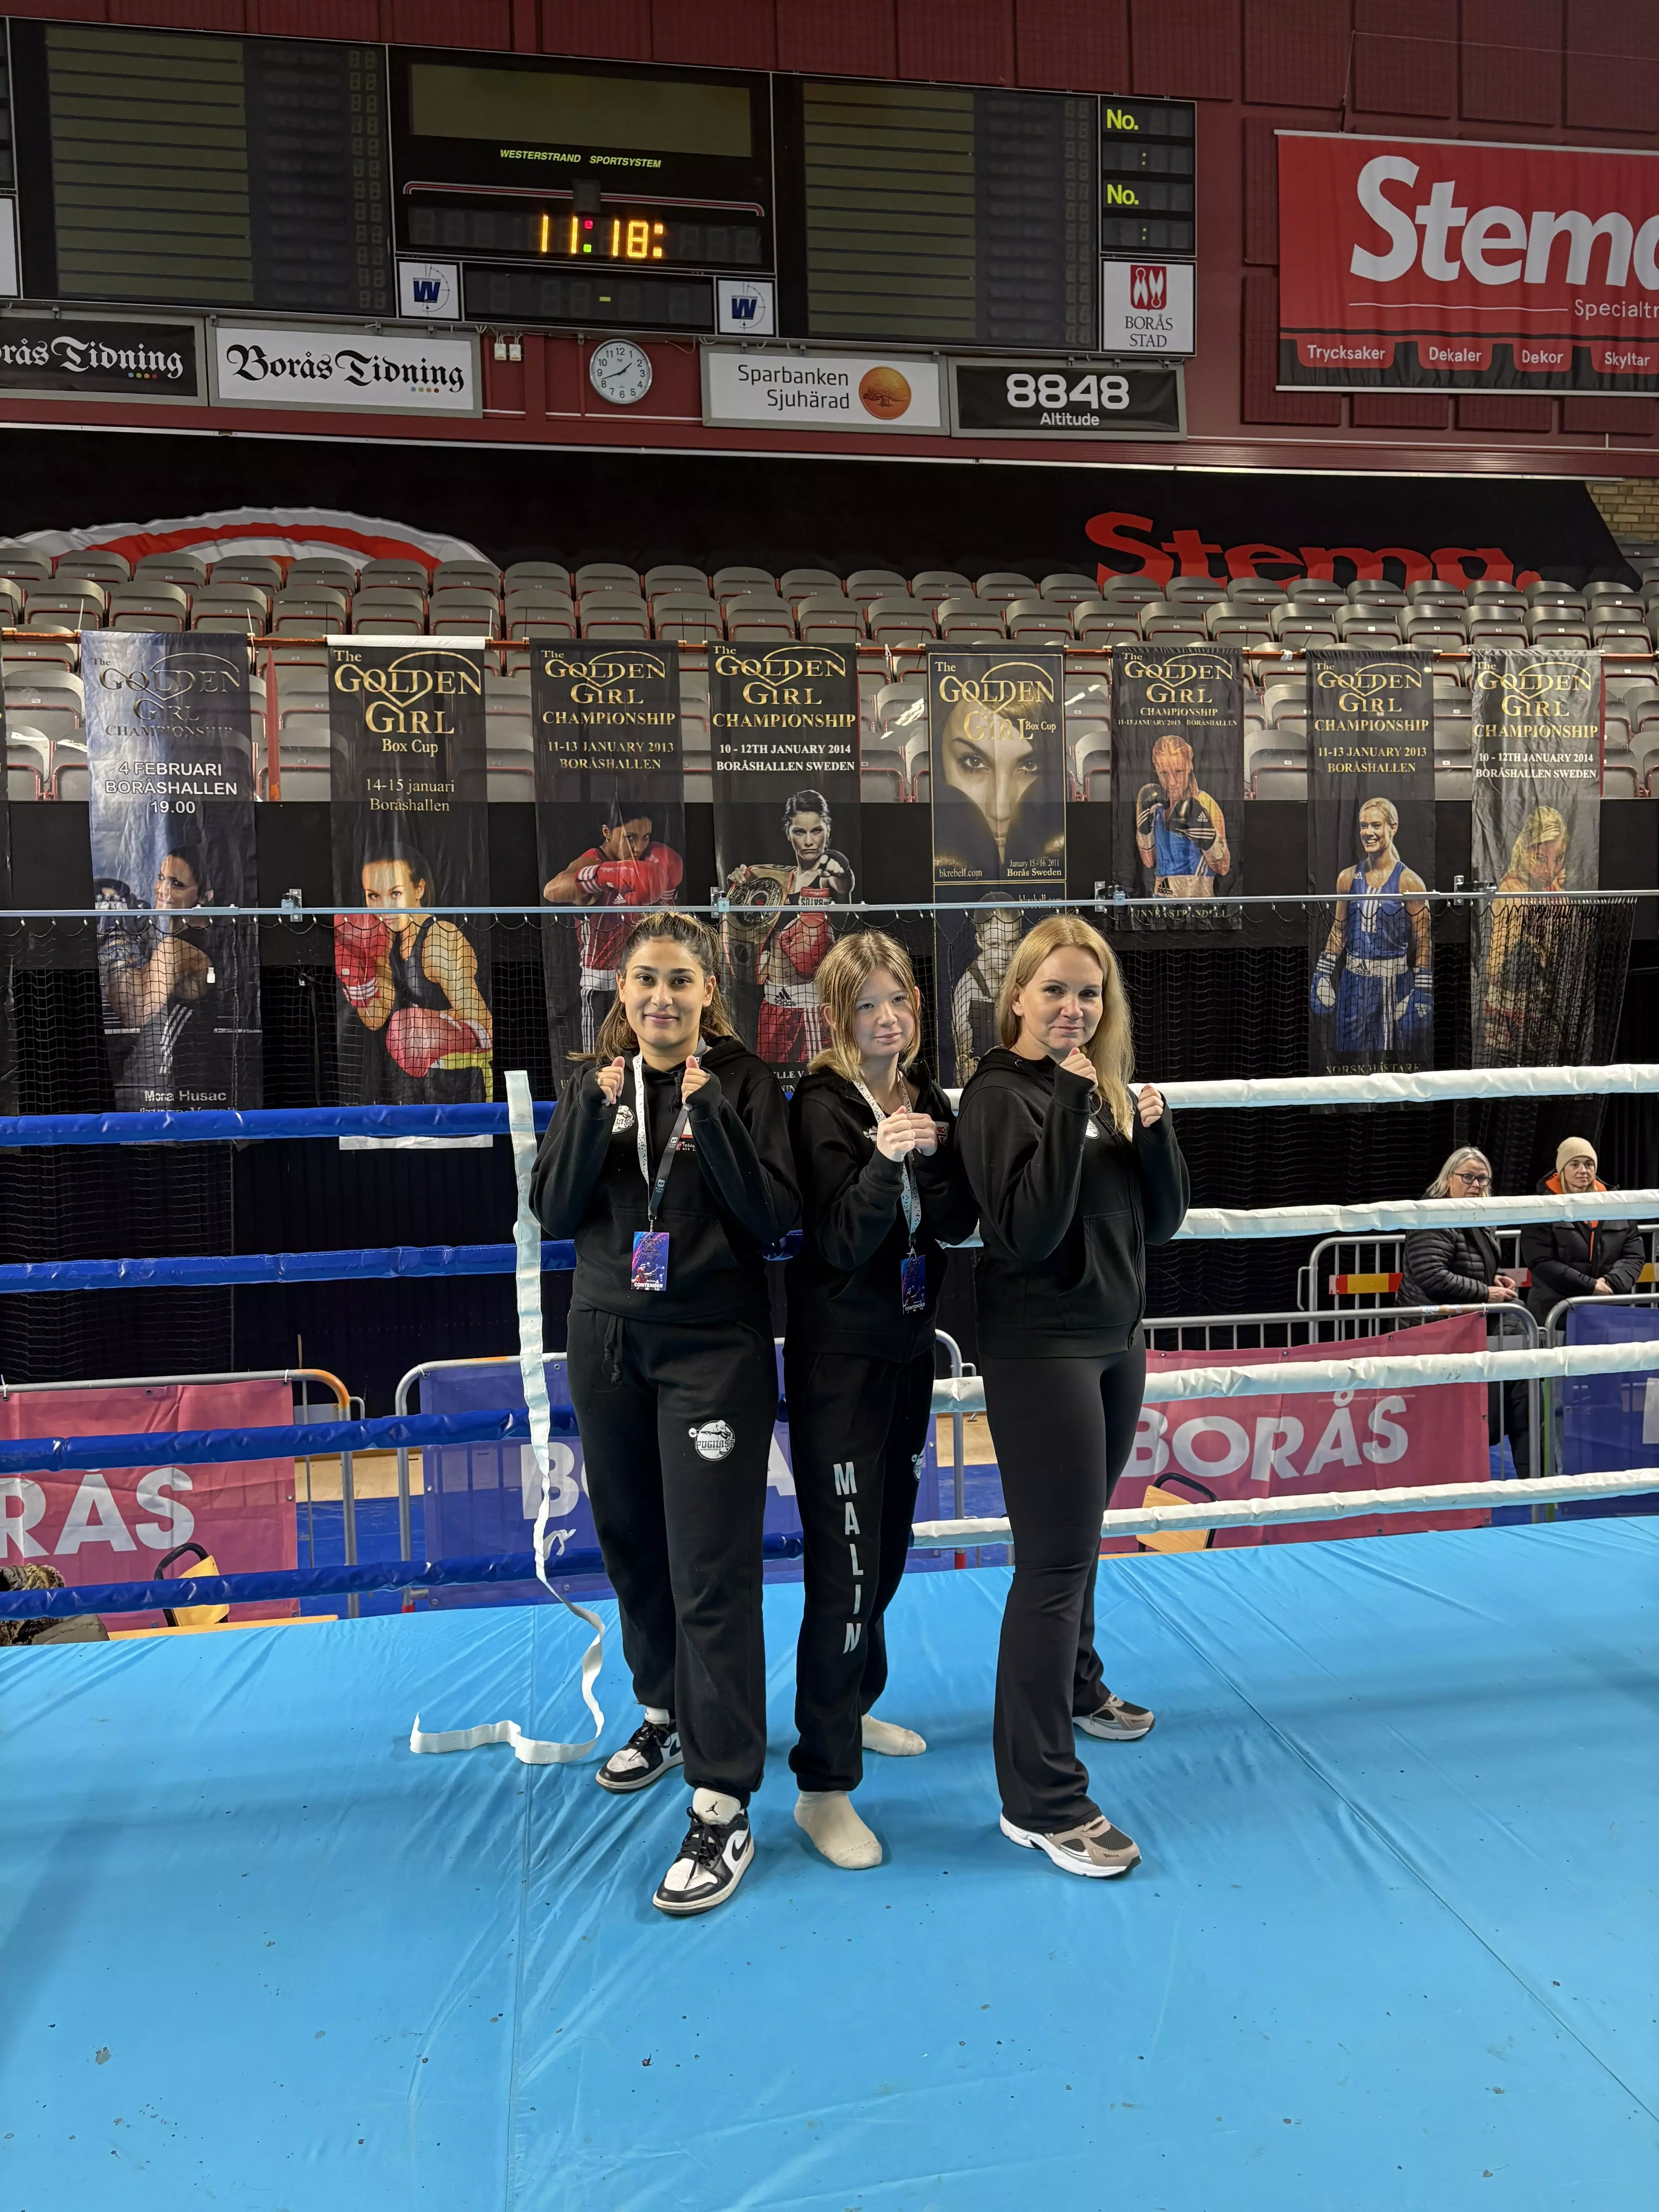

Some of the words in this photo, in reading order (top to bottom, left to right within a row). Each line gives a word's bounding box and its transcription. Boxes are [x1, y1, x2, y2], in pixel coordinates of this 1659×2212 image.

[1106, 109, 1139, 130] No.
[500, 149, 581, 163] WESTERSTRAND
[589, 155, 661, 168] SPORTSYSTEM
[1106, 184, 1139, 205] No.
[1125, 314, 1173, 331] BORÅS
[1129, 333, 1167, 348] STAD
[51, 336, 183, 378] Tidning
[1307, 345, 1385, 362] Trycksaker
[1429, 347, 1482, 363] Dekaler
[1522, 350, 1564, 364] Dekor
[1604, 352, 1650, 368] Skyltar
[227, 344, 333, 381] Borås
[335, 349, 464, 392] Tidning
[738, 364, 849, 386] Sparbanken
[767, 388, 850, 409] Sjuhärad
[1006, 374, 1130, 409] 8848
[1040, 412, 1100, 426] Altitude
[333, 650, 362, 662] The
[541, 650, 565, 659] The
[713, 646, 737, 654] The
[1121, 652, 1142, 661] The
[91, 657, 111, 666] The
[934, 661, 956, 672] The
[1476, 661, 1496, 670] The
[544, 659, 666, 688] GOLDEN
[715, 655, 846, 687] GOLDEN
[1125, 661, 1232, 688] GOLDEN
[99, 668, 240, 701] GOLDEN
[334, 664, 482, 708] GOLDEN
[1317, 671, 1422, 697] GOLDEN
[1477, 670, 1591, 700] GOLDEN
[570, 682, 644, 704] GIRL
[743, 681, 822, 705] GIRL
[939, 675, 1054, 714] GOLDEN
[1146, 683, 1212, 703] GIRL
[133, 699, 199, 721] GIRL
[1338, 692, 1402, 713] GIRL
[1502, 695, 1570, 717] GIRL
[365, 701, 455, 735] GIRL
[542, 711, 676, 726] CHAMPIONSHIP
[1140, 707, 1218, 716] CHAMPIONSHIP
[712, 713, 856, 728] CHAMPIONSHIP
[963, 711, 1034, 740] GIRL
[1025, 721, 1039, 730] Box
[1041, 721, 1056, 733] Cup
[1314, 719, 1429, 732] CHAMPIONSHIP
[105, 725, 233, 738] CHAMPIONSHIP
[1473, 724, 1598, 738] CHAMPIONSHIP
[381, 738, 408, 752] Box
[411, 739, 439, 757] Cup
[548, 741, 578, 752] 11-13
[583, 741, 644, 752] JANUARY
[648, 742, 674, 753] 2013
[720, 744, 731, 754] 10
[740, 744, 768, 754] 12TH
[770, 744, 826, 754] JANUARY
[828, 744, 851, 754] 2014
[1318, 747, 1344, 757] 11-13
[1346, 747, 1402, 757] JANUARY
[1404, 747, 1427, 757] 2013
[560, 756, 661, 770] BORÅSHALLEN
[716, 759, 804, 771] BORÅSHALLEN
[806, 761, 855, 771] SWEDEN
[1479, 753, 1489, 762] 10
[1498, 752, 1521, 762] 12TH
[1523, 753, 1571, 763] JANUARY
[1573, 753, 1594, 763] 2014
[118, 762, 129, 775] 4
[134, 762, 222, 776] FEBRUARI
[1328, 761, 1416, 773] BORÅSHALLEN
[1475, 767, 1552, 778] BORÅSHALLEN
[1553, 769, 1597, 778] SWEDEN
[105, 778, 237, 795] BORÅSHALLEN
[366, 778, 404, 792] 14-15
[406, 779, 455, 795] januari
[150, 801, 196, 814] 19.00
[369, 797, 450, 812] Boråshallen
[1009, 859, 1028, 869] January
[1007, 868, 1029, 877] Borås
[1031, 867, 1062, 876] Sweden
[773, 1071, 795, 1079] LLE
[179, 1090, 227, 1101] Husac
[1122, 1389, 1410, 1482] BORÅS
[696, 1439, 735, 1449] PUGILIST
[833, 1462, 864, 1654] MALIN
